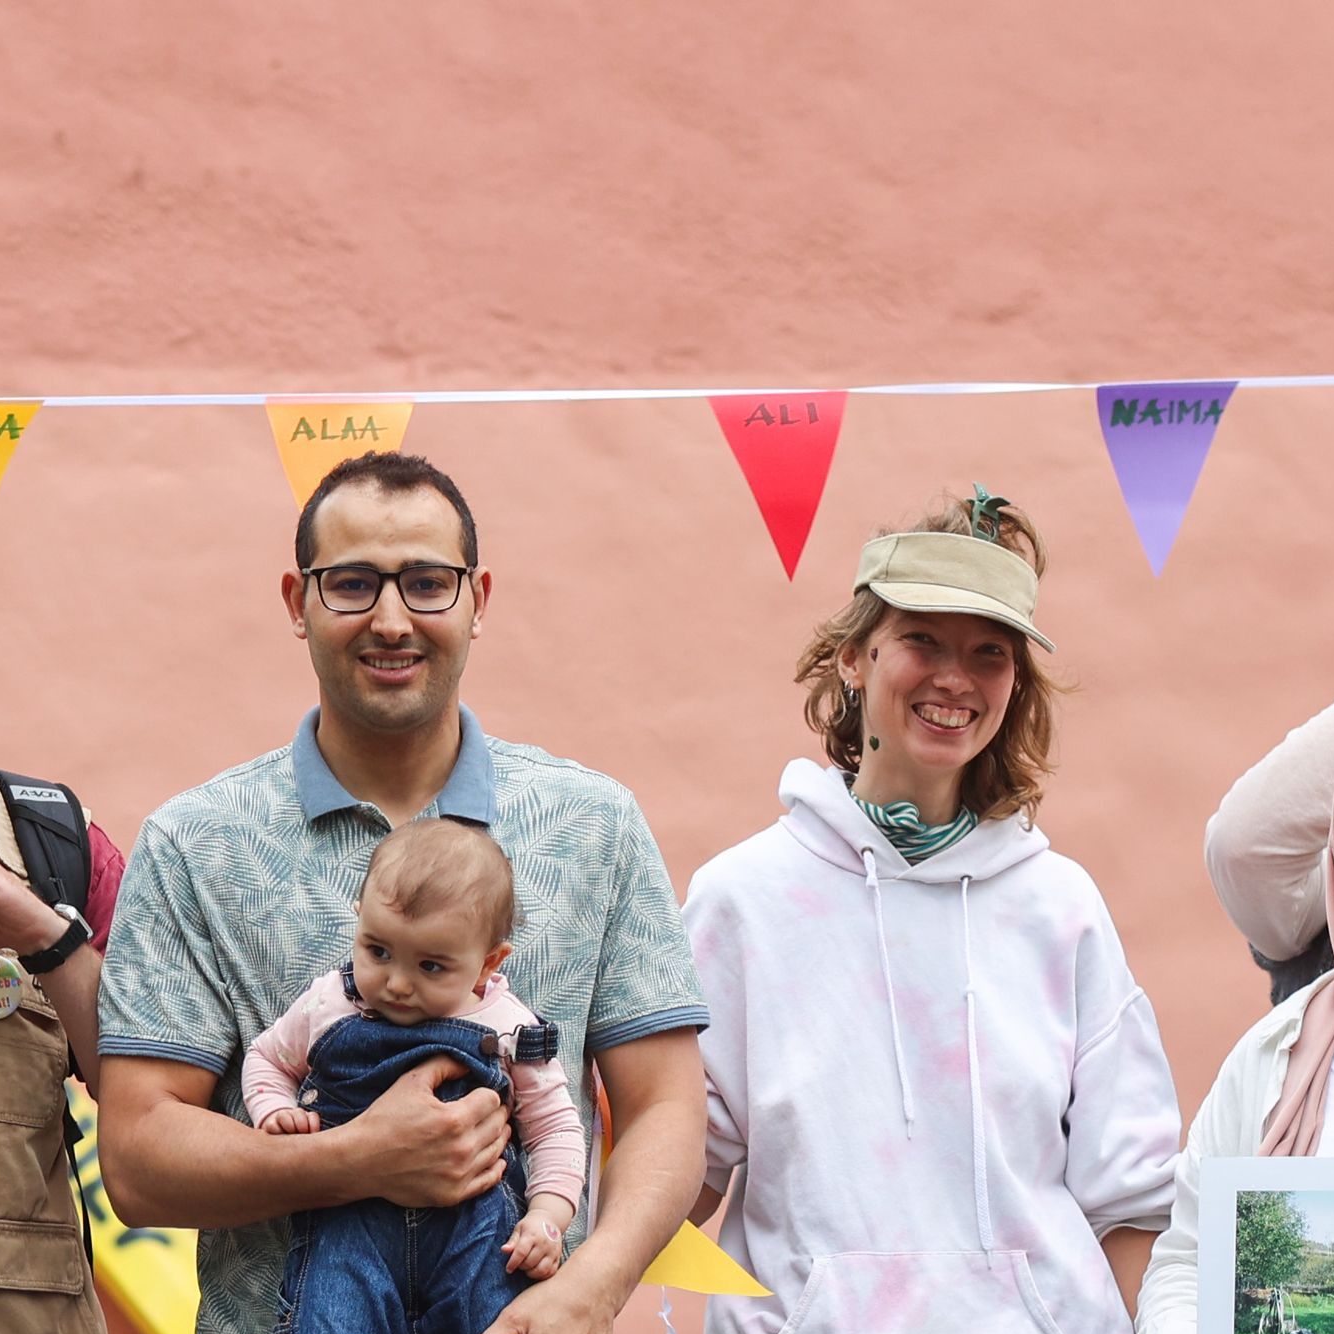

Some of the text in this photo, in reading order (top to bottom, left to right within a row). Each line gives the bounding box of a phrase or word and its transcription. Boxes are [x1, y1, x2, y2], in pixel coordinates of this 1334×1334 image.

[743, 402, 820, 426] ALI
[1110, 397, 1224, 428] NAIMA
[290, 415, 388, 441] ALAA
